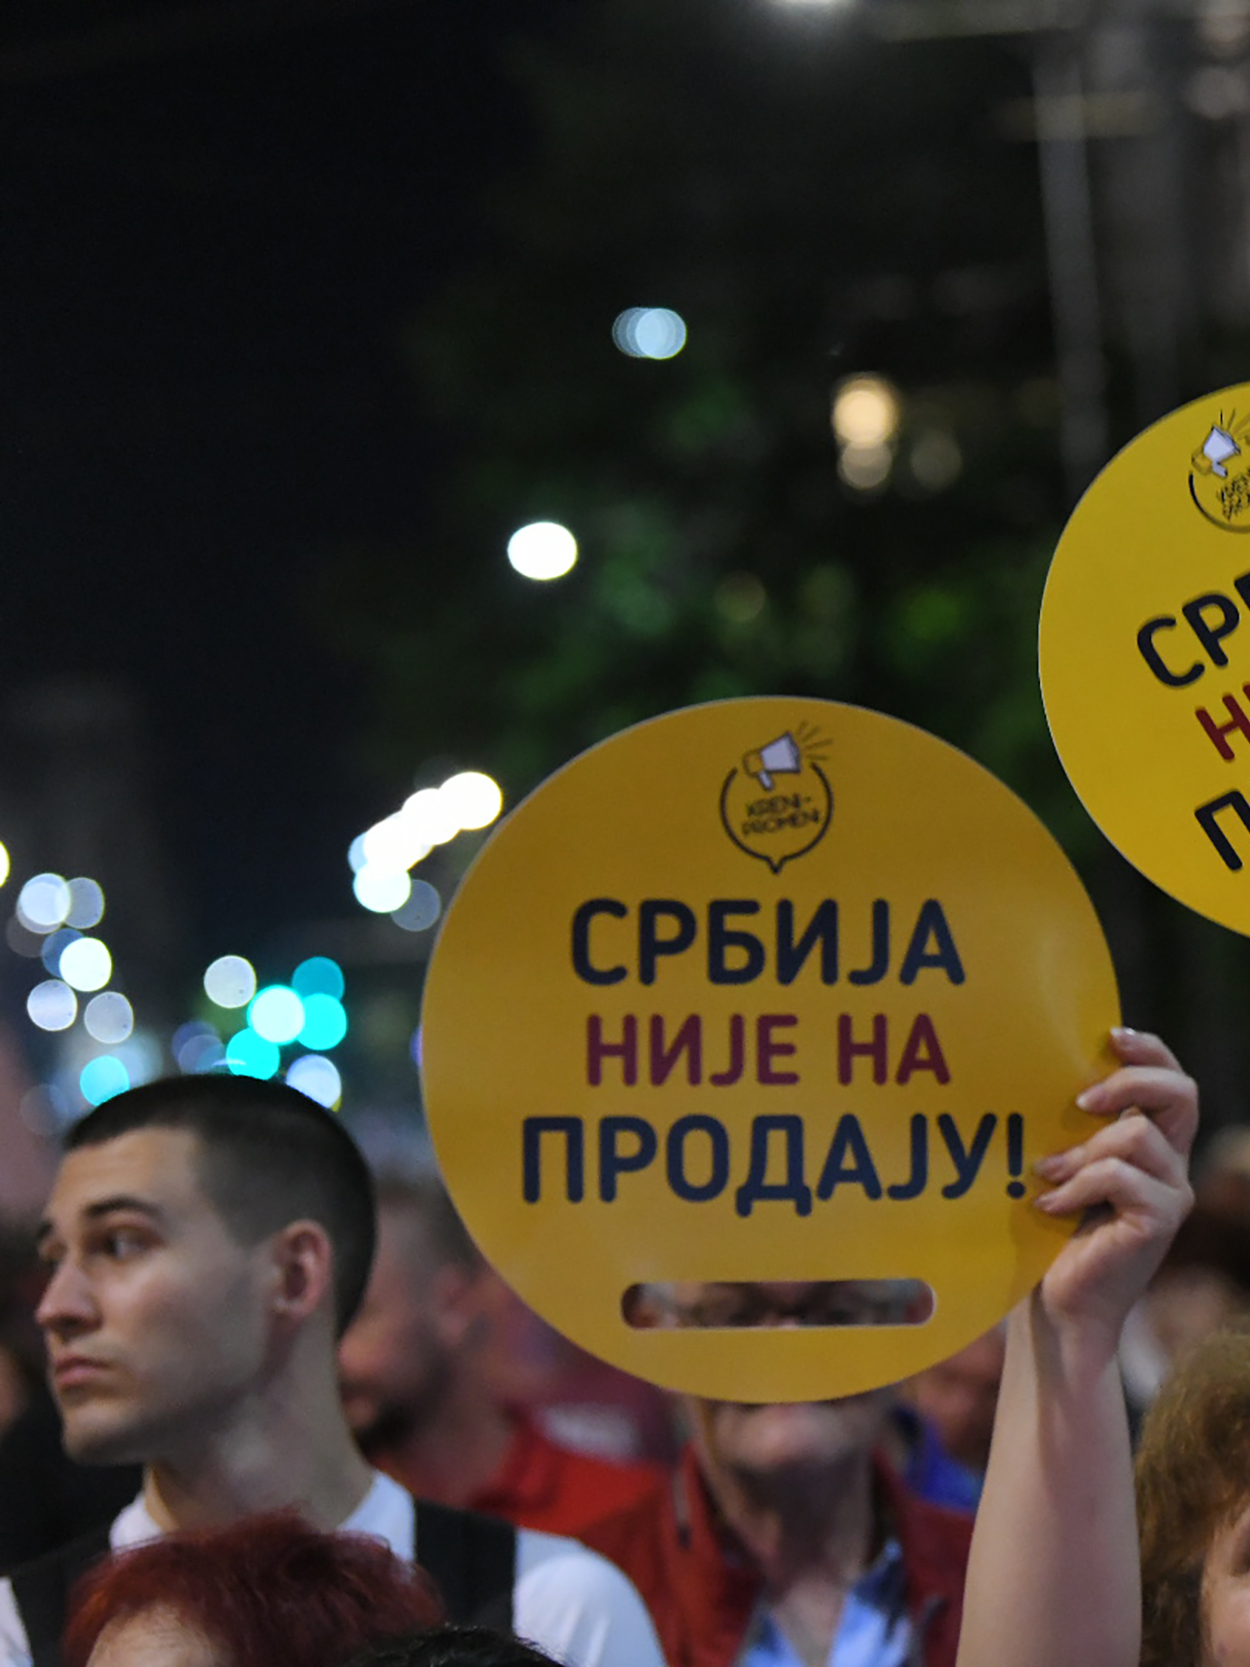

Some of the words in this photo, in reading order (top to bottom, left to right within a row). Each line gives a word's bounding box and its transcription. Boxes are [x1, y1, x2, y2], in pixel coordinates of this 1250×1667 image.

[569, 896, 967, 987] СРБИЈА
[586, 1012, 801, 1087] НИЈЕ
[836, 1012, 952, 1087] НА
[521, 1111, 1028, 1218] ПРОДАЈУ!
